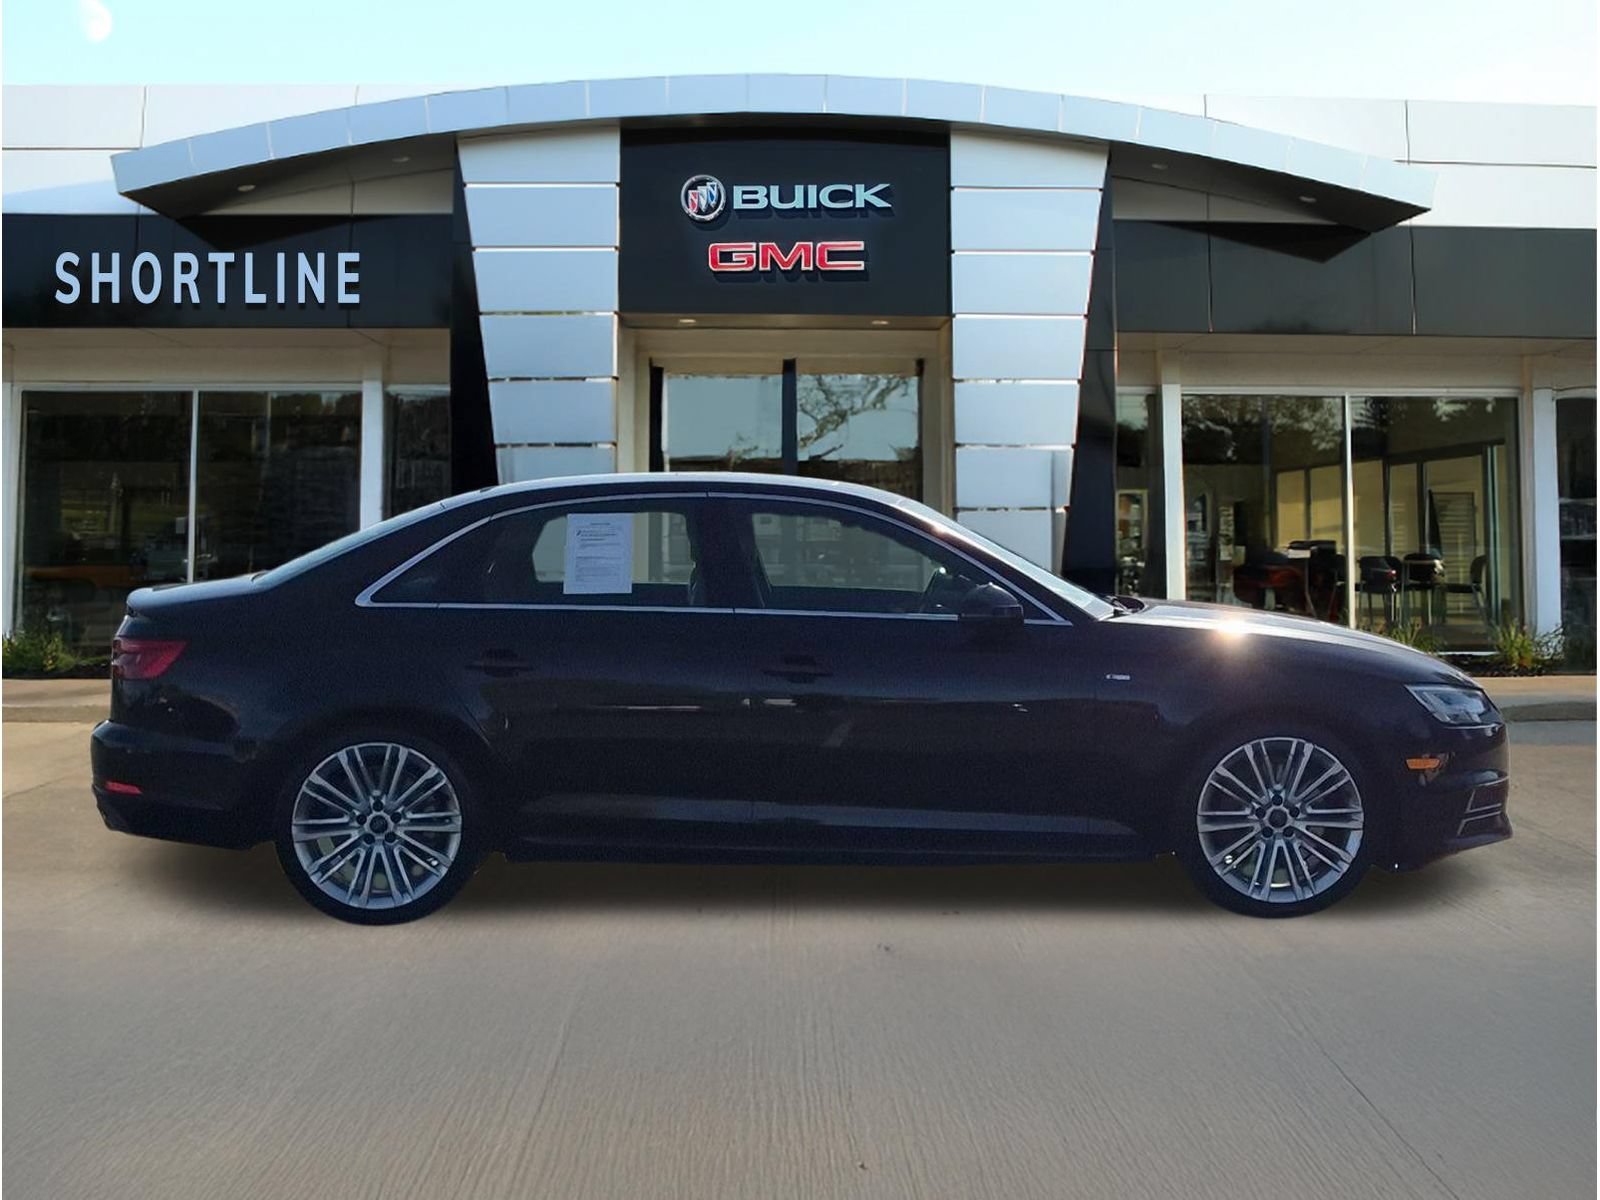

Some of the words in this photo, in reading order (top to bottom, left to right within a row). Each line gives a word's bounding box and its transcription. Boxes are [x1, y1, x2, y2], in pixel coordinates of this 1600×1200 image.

[733, 183, 892, 209] BUICK
[708, 241, 865, 272] GMC
[55, 252, 360, 304] SHORTLINE
